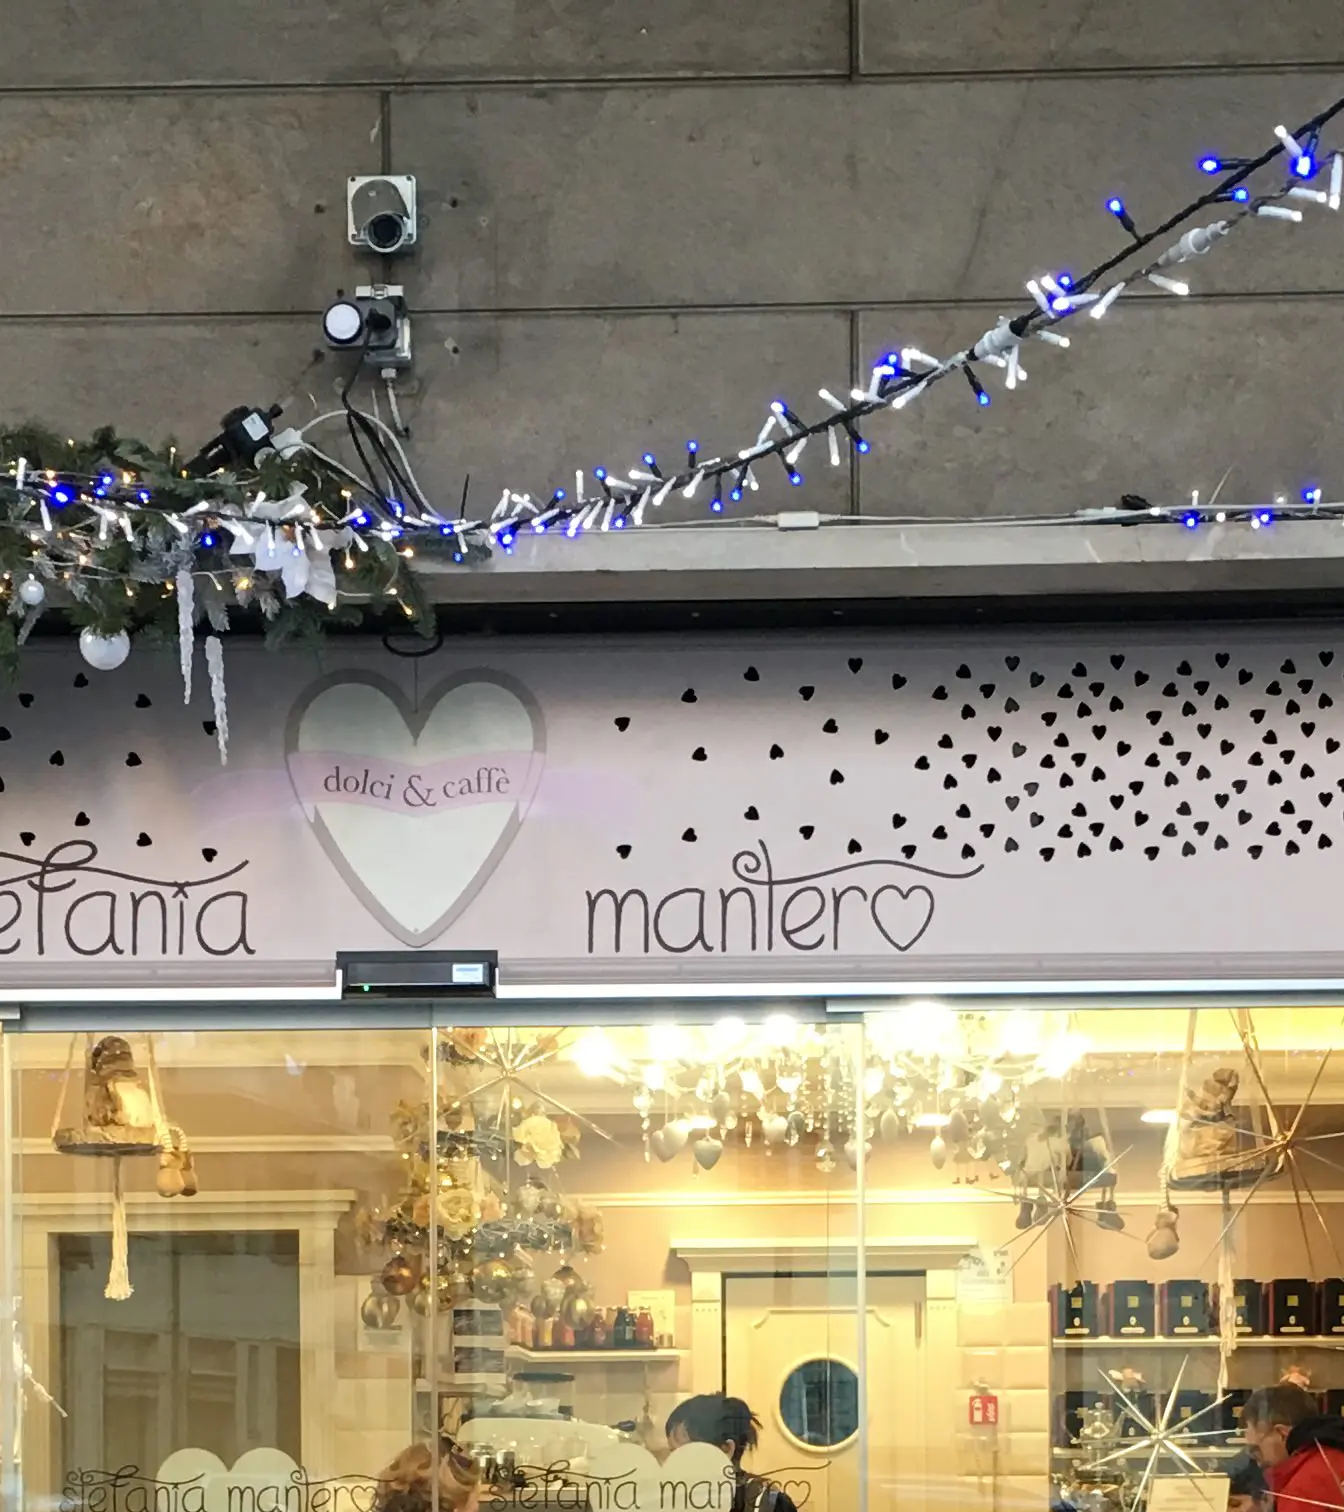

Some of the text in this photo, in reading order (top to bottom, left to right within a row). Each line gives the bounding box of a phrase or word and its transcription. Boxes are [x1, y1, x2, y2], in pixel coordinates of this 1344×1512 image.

[323, 765, 510, 807] dolci & caffè
[488, 1459, 833, 1512] stefania manro
